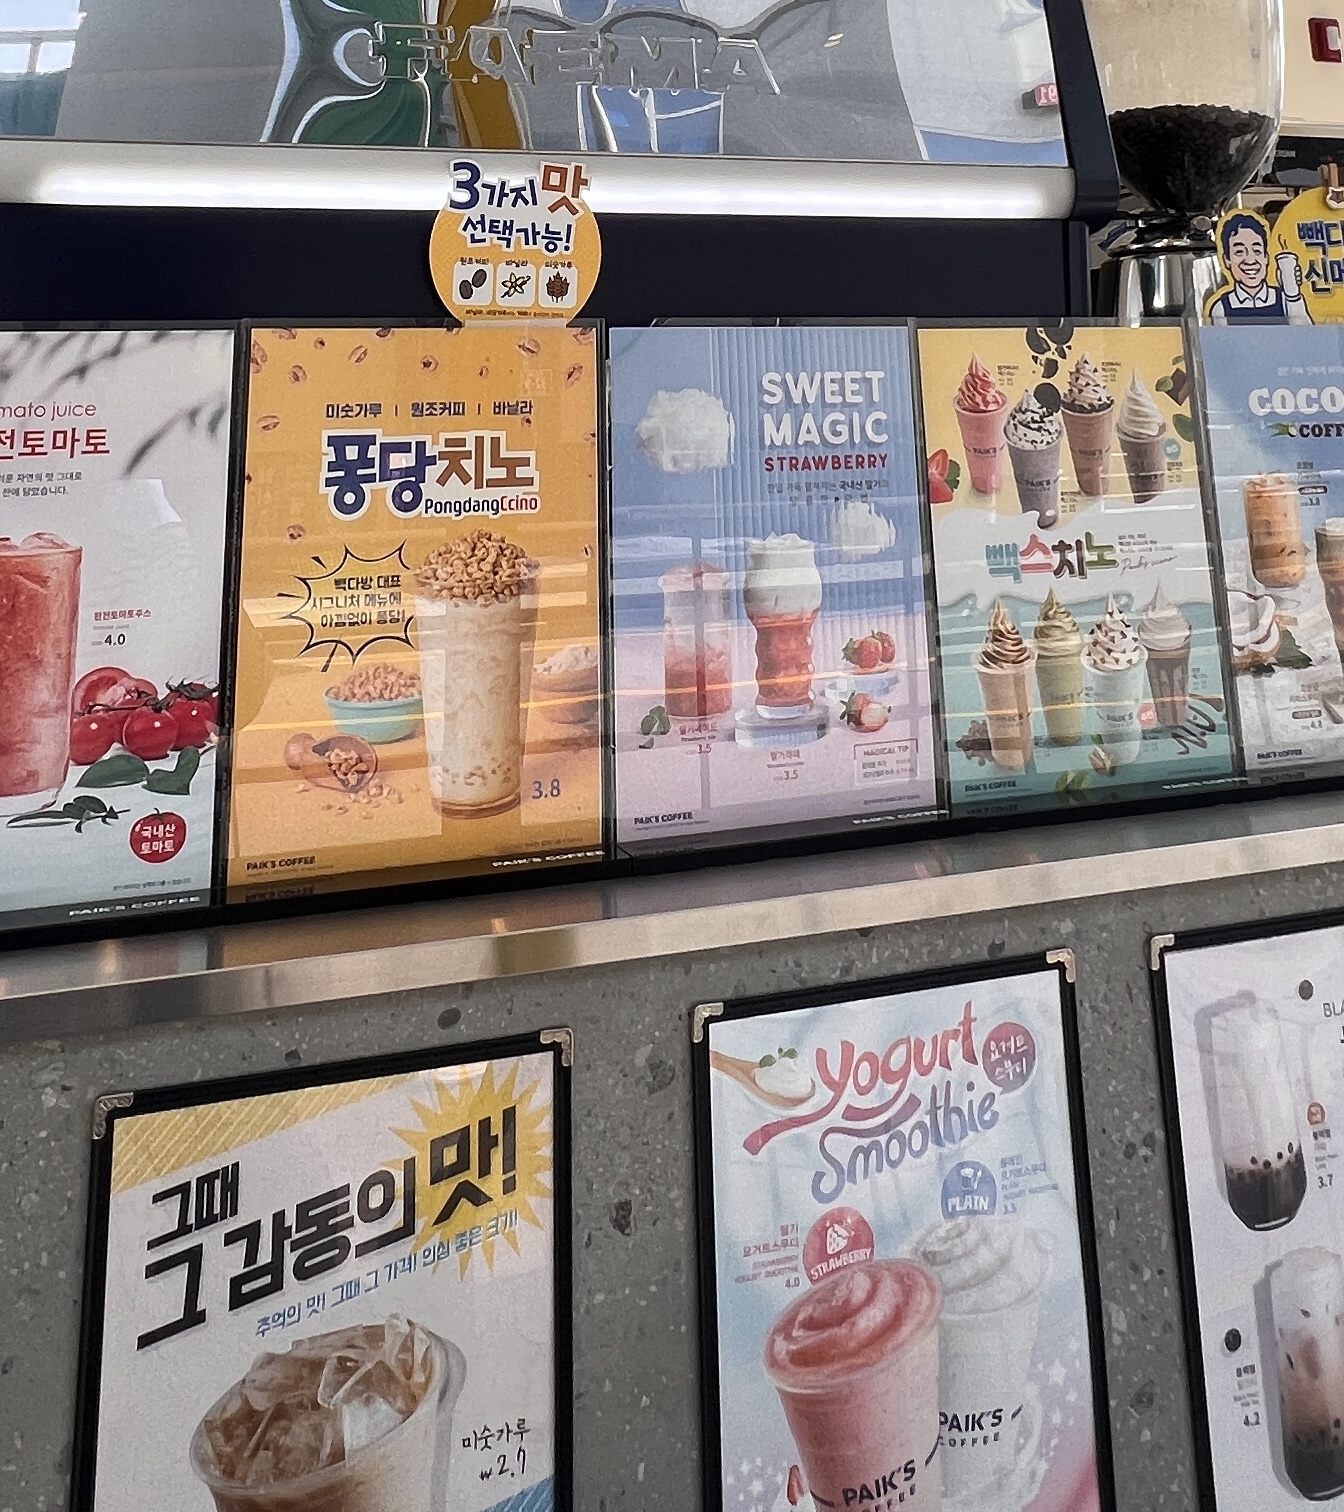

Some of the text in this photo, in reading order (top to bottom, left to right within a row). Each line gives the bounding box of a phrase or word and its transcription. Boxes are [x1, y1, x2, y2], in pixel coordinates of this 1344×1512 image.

[449, 161, 589, 216] 3가지 맛
[462, 214, 572, 253] 선택가능!
[761, 370, 886, 406] SWEET
[49, 399, 97, 421] juice
[326, 400, 533, 419] 미숫가루 원조커피 바닐라
[764, 412, 889, 447] MAGIC
[764, 453, 888, 472] STRAWBERRY
[57, 472, 82, 481] 그대로
[325, 434, 534, 516] 퐁당치노
[425, 496, 538, 516] PongdangCcino
[986, 532, 1120, 583] 빽스치노
[334, 575, 401, 591] 빽다방 대표
[311, 592, 402, 611] 시그니처 메뉴에
[104, 634, 125, 646] 4.0
[531, 779, 562, 801] 3.8
[661, 812, 693, 822] COFFEE
[141, 823, 177, 841] 국내산
[140, 839, 175, 855] 토마토
[246, 856, 316, 873] PAIK'S COFFEE
[743, 1000, 981, 1155] Yogurt
[811, 1081, 999, 1204] Smoothie
[1318, 1174, 1334, 1189] 3.7
[145, 1161, 240, 1251] 그때
[947, 1194, 990, 1213] PLAIN
[136, 1104, 518, 1351] 그 감동의 맛!
[810, 1247, 873, 1281] STRAWBERRY
[256, 1302, 301, 1337] 추억의
[331, 1277, 361, 1308] 그때
[365, 1269, 379, 1294] 그
[939, 1407, 1004, 1433] PAIK'S
[462, 1418, 531, 1450] 미숫가루
[841, 1462, 916, 1504] PAIK'S
